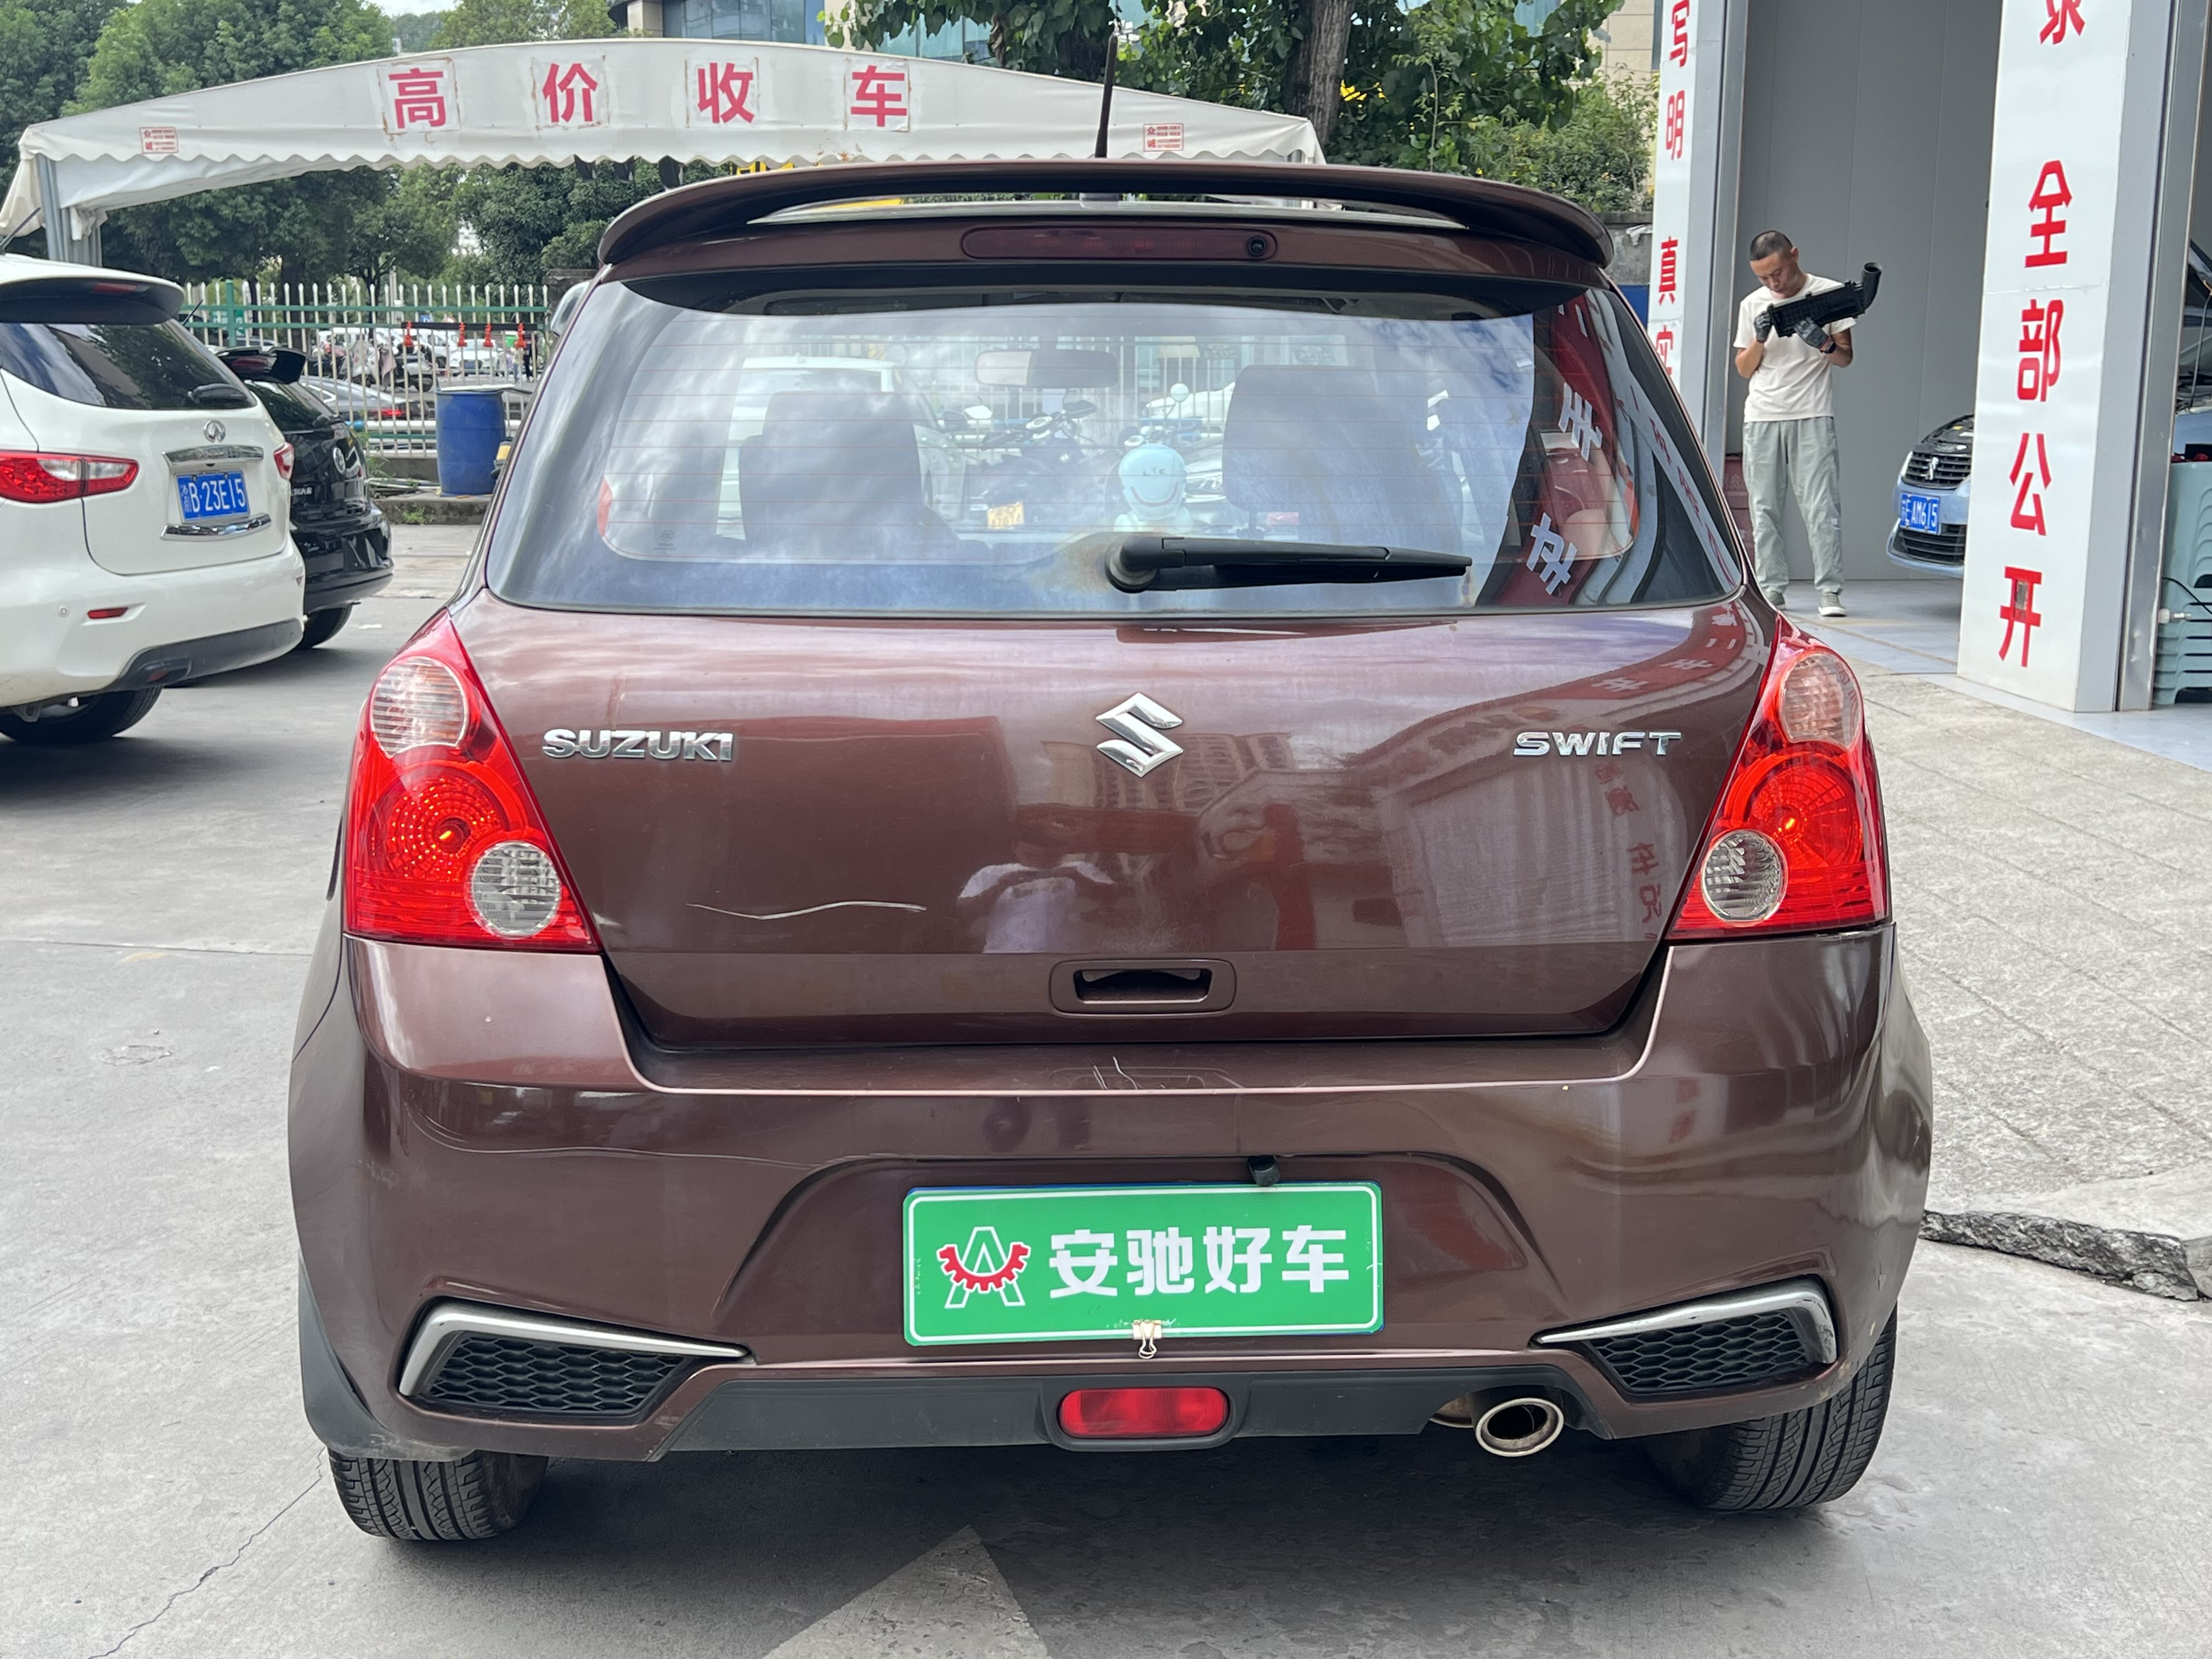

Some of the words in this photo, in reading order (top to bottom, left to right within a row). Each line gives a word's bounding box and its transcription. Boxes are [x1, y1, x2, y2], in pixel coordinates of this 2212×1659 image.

[388, 61, 908, 130] 高价收车
[1998, 160, 2073, 668] 全部公开
[542, 728, 734, 761] SUZUKI
[1513, 731, 1682, 756] SWIFT
[1048, 1223, 1350, 1298] 安驰好车
